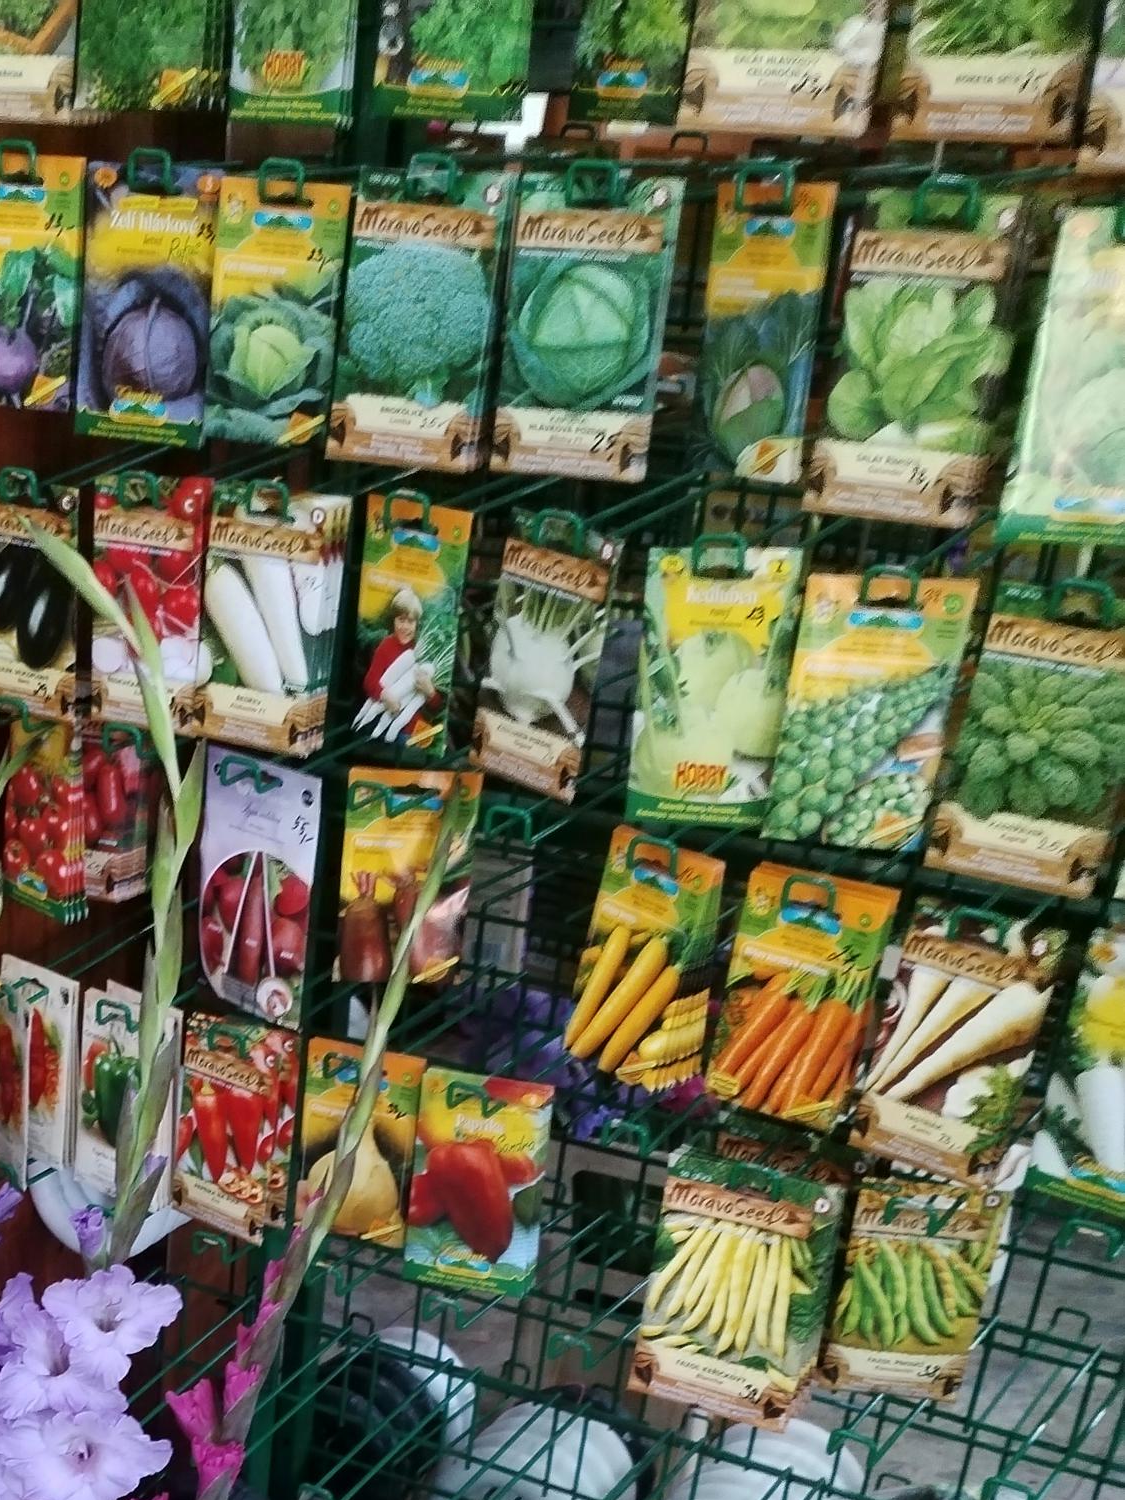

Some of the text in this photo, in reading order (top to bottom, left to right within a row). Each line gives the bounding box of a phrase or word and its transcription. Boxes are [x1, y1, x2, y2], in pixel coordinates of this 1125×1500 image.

[357, 205, 471, 241] MoravoSeed
[521, 213, 636, 249] MoravoSeed
[855, 236, 980, 273] MoravoSeed
[96, 512, 178, 545] MoravoSeed
[212, 521, 302, 556] MoravoSeed
[987, 620, 1120, 663] MoravoSeed
[675, 761, 728, 789] HOBBY
[905, 935, 1018, 982] MoravoSeed
[186, 1049, 260, 1090] MoravoSeed
[667, 1182, 783, 1226] MoravoSeed
